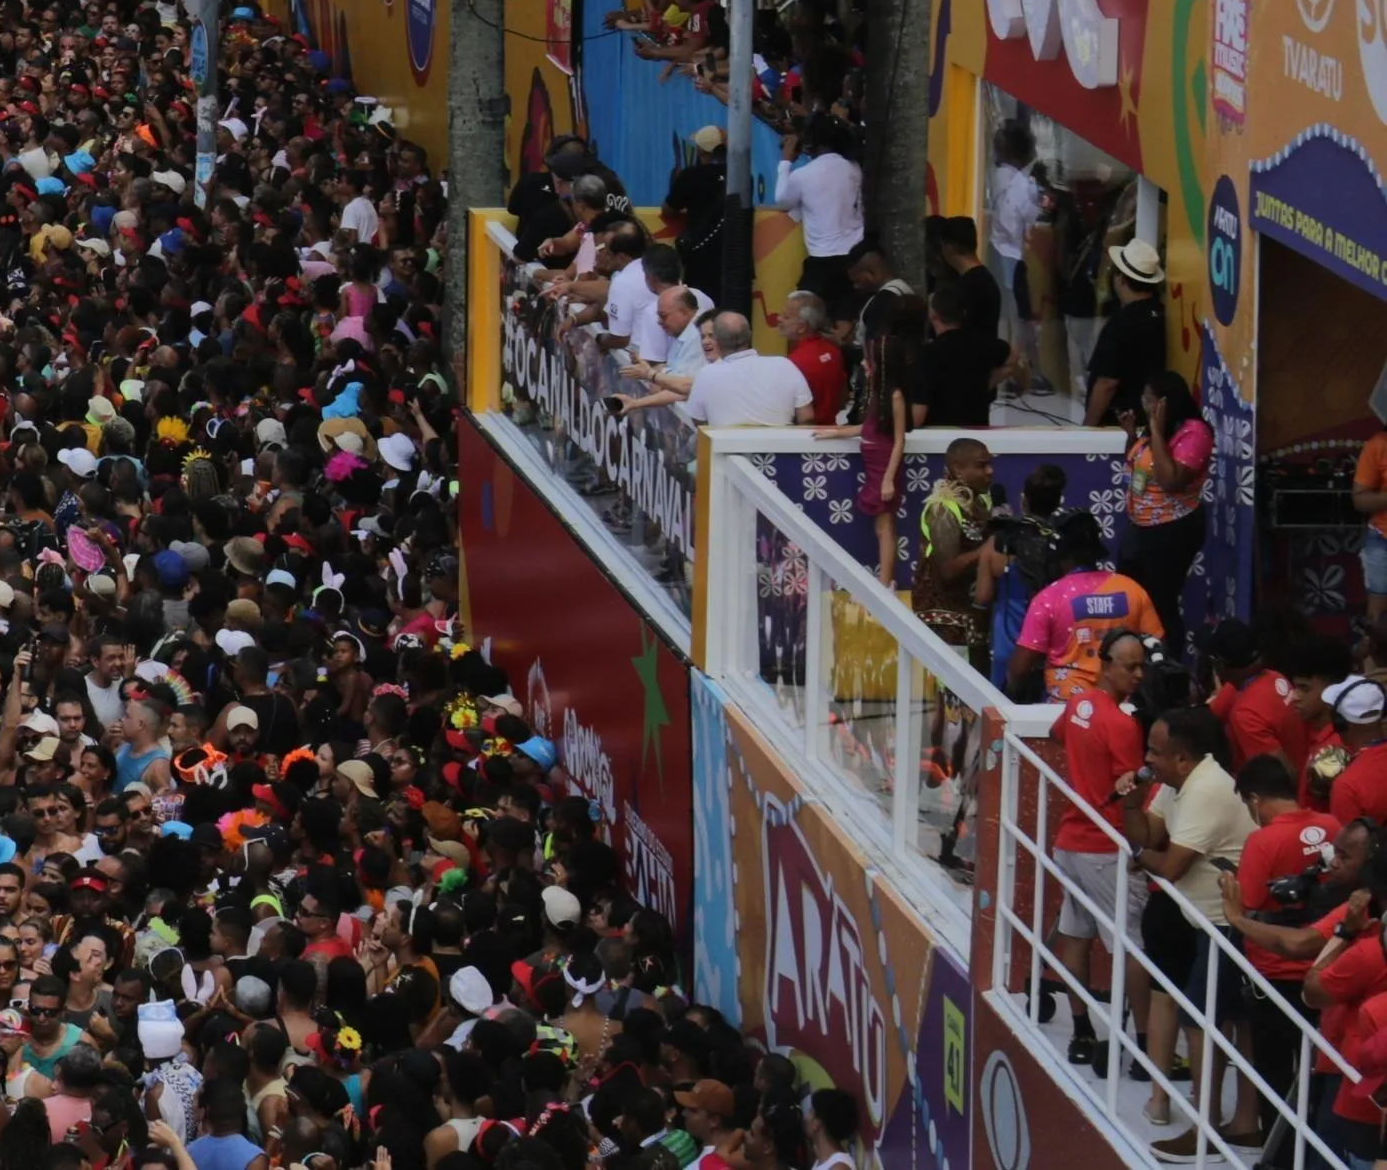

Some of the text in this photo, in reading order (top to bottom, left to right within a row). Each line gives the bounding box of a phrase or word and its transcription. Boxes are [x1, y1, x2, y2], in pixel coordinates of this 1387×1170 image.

[1255, 190, 1294, 231] JUNTAS
[1295, 209, 1324, 247] PARA
[1324, 227, 1333, 252] A
[1334, 232, 1380, 282] MELHOR
[1086, 596, 1114, 615] STAFF
[772, 856, 885, 1128] ARATU
